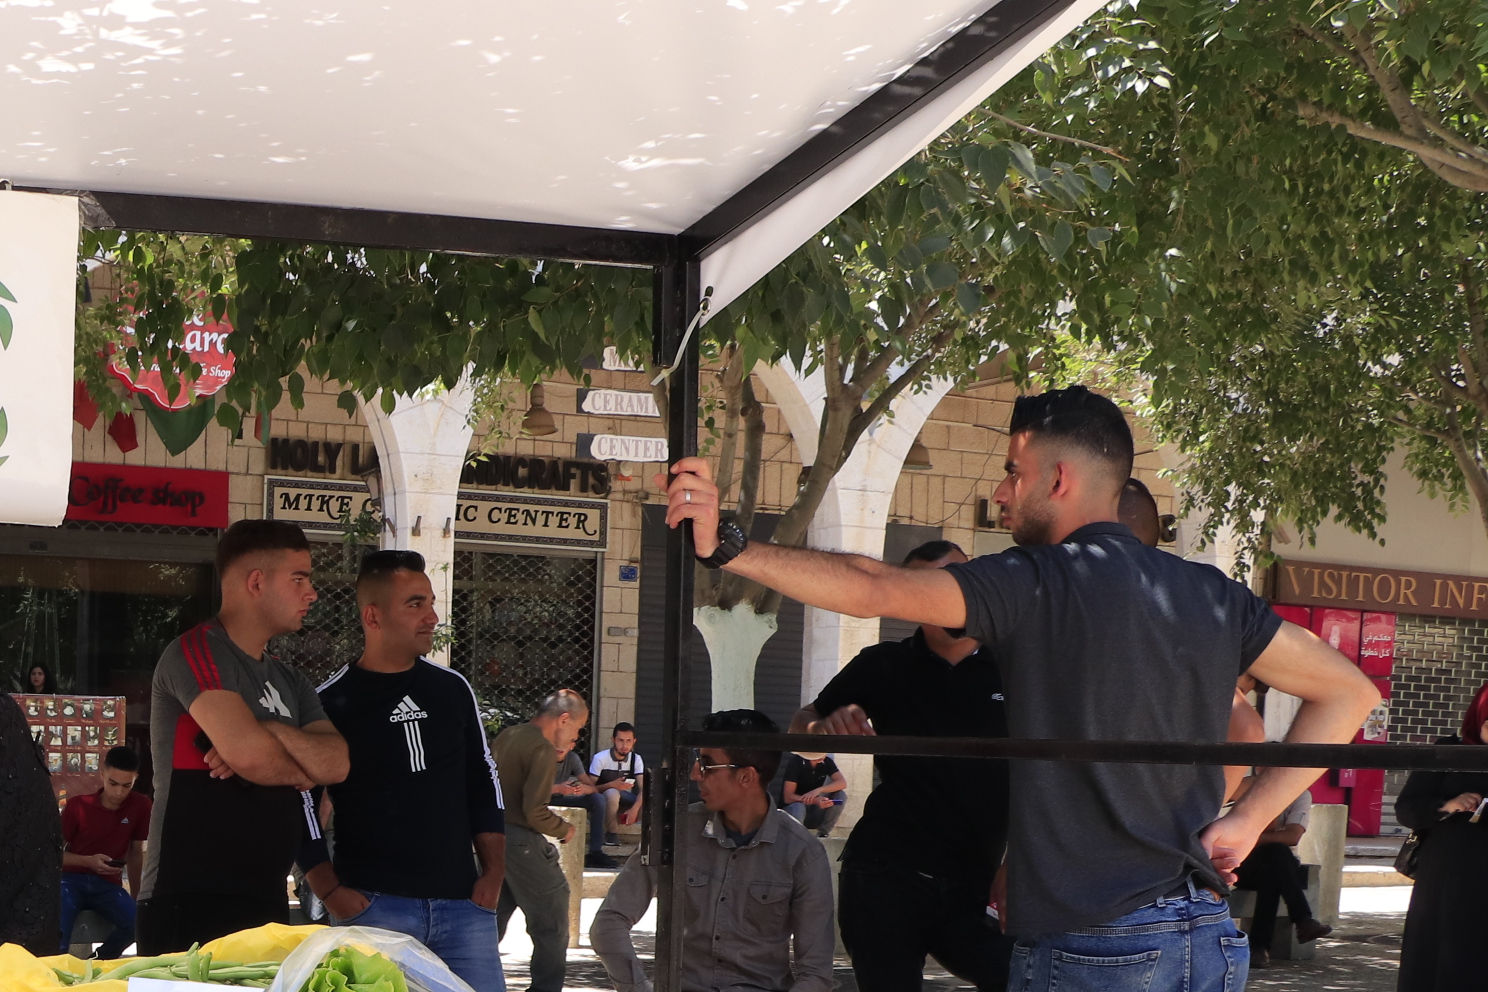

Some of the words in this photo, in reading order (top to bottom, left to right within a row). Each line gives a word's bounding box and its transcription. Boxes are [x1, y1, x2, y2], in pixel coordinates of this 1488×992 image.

[209, 364, 232, 382] Shop
[591, 391, 659, 415] CERAMI
[269, 437, 342, 474] HOLY
[597, 436, 667, 460] CENTER
[69, 475, 145, 516] Coffee
[152, 480, 206, 518] shop
[279, 491, 353, 521] MIKE
[487, 506, 597, 537] CENTER
[1285, 565, 1419, 606] VISITOR
[389, 710, 428, 723] adidas
